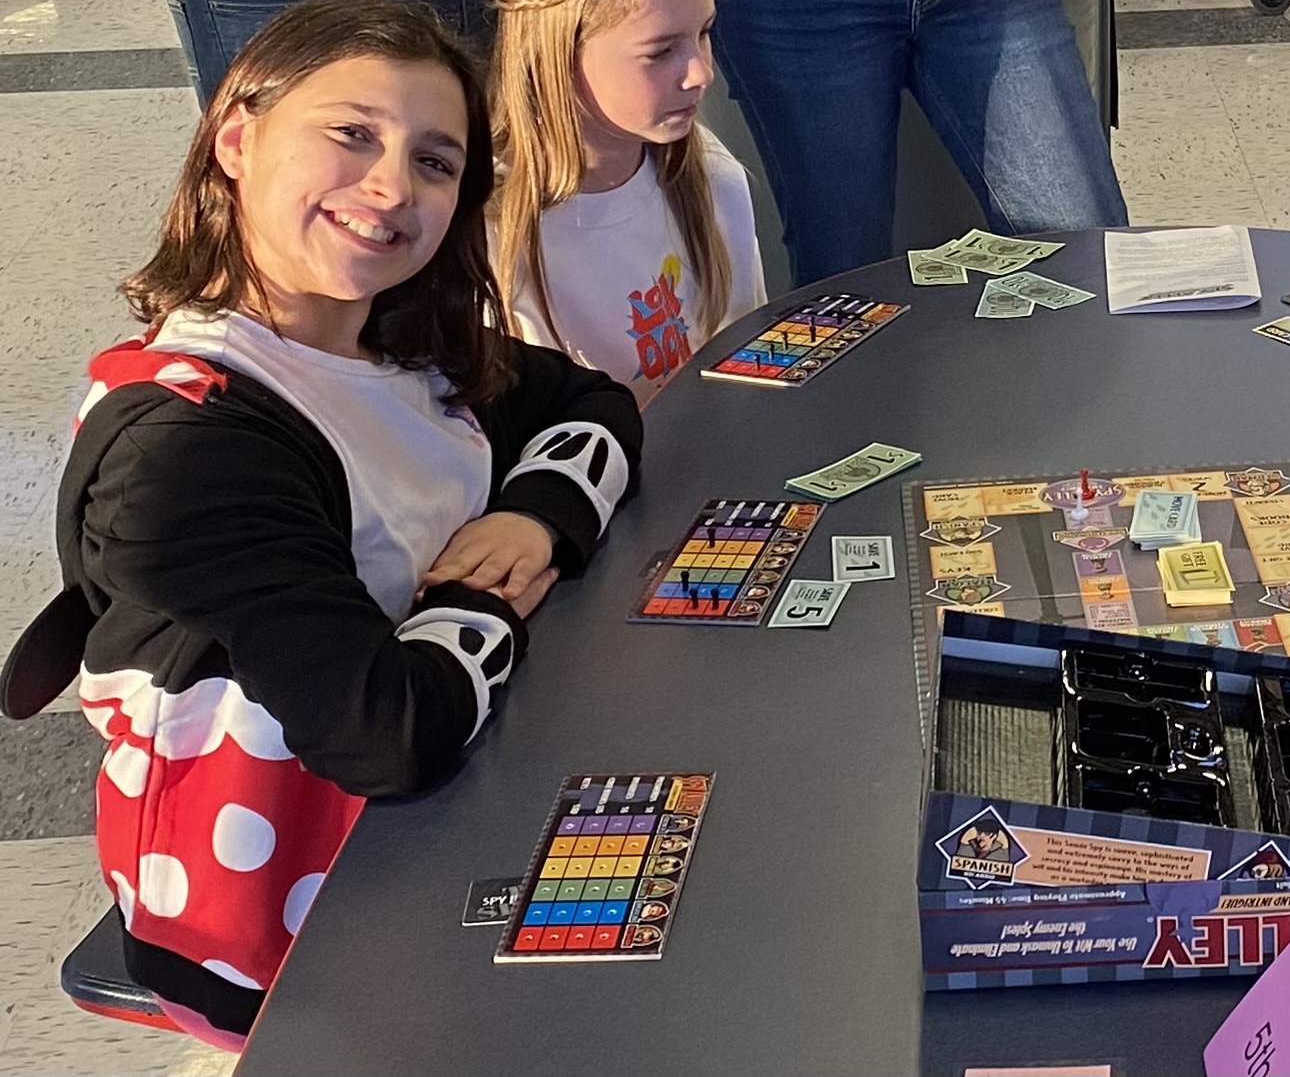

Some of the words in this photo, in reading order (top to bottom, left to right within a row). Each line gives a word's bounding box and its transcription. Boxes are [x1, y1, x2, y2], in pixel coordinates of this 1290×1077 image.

[845, 561, 880, 571] 1
[787, 605, 824, 619] 5
[954, 858, 1010, 875] SPANISH
[482, 895, 507, 906] SPY
[959, 897, 994, 906] Minutes
[1033, 892, 1068, 902] Playing
[1069, 890, 1127, 901] Approximate
[1220, 897, 1275, 909] INTRIGUE!
[999, 920, 1034, 940] Spies!
[1032, 920, 1069, 938] Enemy
[1068, 922, 1087, 938] the
[950, 942, 999, 958] Eliminate
[998, 942, 1021, 957] and
[1020, 941, 1062, 956] Unmask
[1062, 940, 1075, 954] To
[1077, 939, 1094, 954] Wit
[1094, 938, 1117, 953] Your
[1118, 937, 1138, 951] Use
